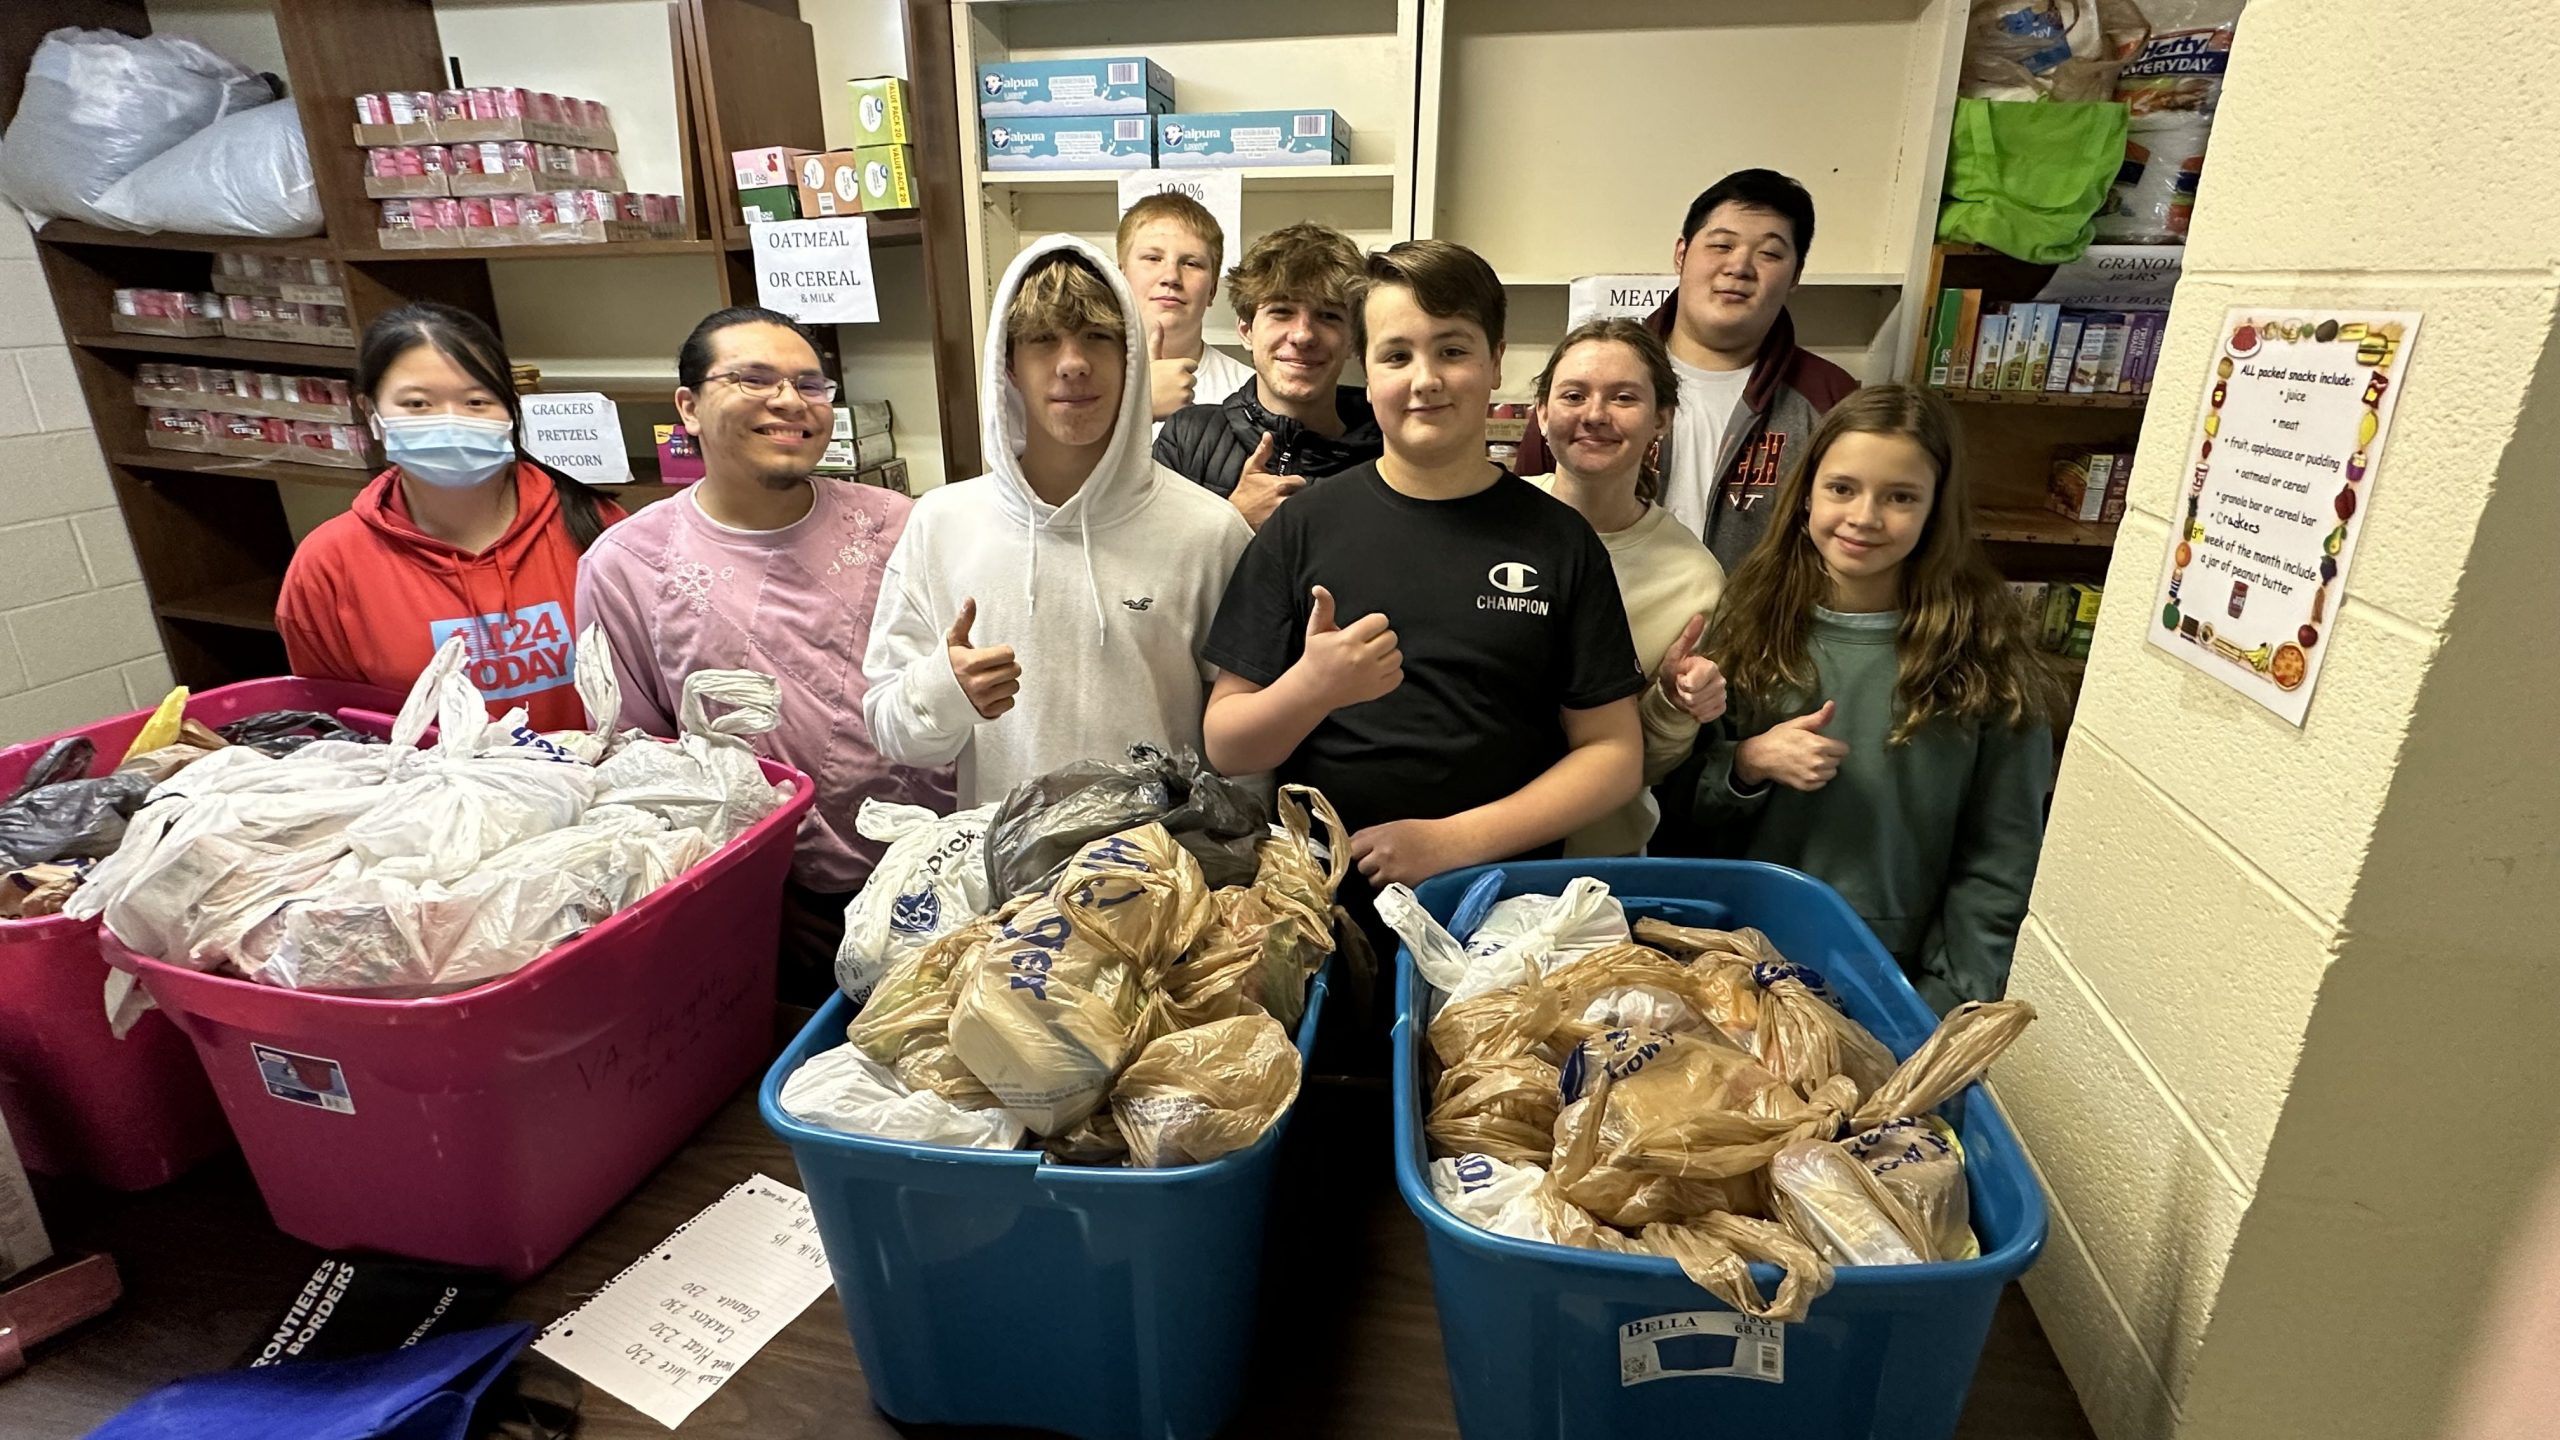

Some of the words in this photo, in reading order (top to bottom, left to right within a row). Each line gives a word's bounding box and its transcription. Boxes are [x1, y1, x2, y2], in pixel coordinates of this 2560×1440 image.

[888, 81, 898, 104] VALUE
[1003, 77, 1039, 90] alpura
[891, 105, 902, 129] PACK
[894, 129, 902, 138] 20
[1010, 131, 1045, 143] alpura
[1184, 128, 1221, 141] alpura
[892, 147, 902, 169] VALUE
[896, 170, 906, 191] PACK
[899, 192, 907, 203] 20
[1157, 183, 1204, 200] 100%
[769, 230, 850, 248] OATMEAL
[2098, 258, 2182, 270] GRANOL
[769, 272, 792, 287] OR
[795, 270, 861, 287] CEREAL
[2110, 272, 2161, 281] BARS
[800, 293, 808, 303] &
[810, 293, 836, 303] MILK
[1610, 289, 1670, 307] MEAT
[2241, 365, 2255, 376] ALL
[2257, 367, 2287, 380] packed
[2288, 370, 2317, 383] snacks
[2319, 372, 2355, 386] include:
[2284, 388, 2306, 403] juice
[531, 402, 594, 416] CRACKERS
[2278, 419, 2300, 431] meat
[537, 428, 599, 442] PRETZELS
[544, 453, 603, 468] POPCORN
[2251, 442, 2293, 459] applesauce
[2294, 453, 2305, 462] or
[2305, 453, 2341, 473] pudding
[2240, 470, 2271, 485] oatmeal
[2271, 477, 2282, 486] or
[2282, 479, 2310, 494] cereal
[2219, 493, 2248, 507] granola
[2248, 498, 2262, 511] bar
[2263, 505, 2273, 514] or
[2274, 507, 2300, 522] cereal
[2301, 512, 2317, 527] bar
[2204, 535, 2224, 549] week
[2225, 541, 2236, 553] of
[2237, 544, 2251, 558] the
[2253, 551, 2281, 570] month
[2283, 558, 2317, 582] include
[2200, 553, 2206, 563] a
[2206, 554, 2220, 568] jar
[2220, 560, 2232, 573] of
[2231, 565, 2262, 584] peanut
[2262, 573, 2293, 596] butter
[1476, 595, 1550, 616] CHAMPION
[464, 643, 569, 692] ODAY
[770, 1232, 792, 1247] 115
[681, 1282, 708, 1298] 230
[285, 1262, 355, 1356] BORDERS
[660, 1297, 689, 1315] 230
[648, 1321, 682, 1344] 230
[689, 1309, 736, 1344] Crackers
[1627, 1316, 1698, 1338] BELLA
[625, 1343, 655, 1365] 230
[681, 1338, 715, 1366] Meat
[658, 1360, 692, 1386] Juice
